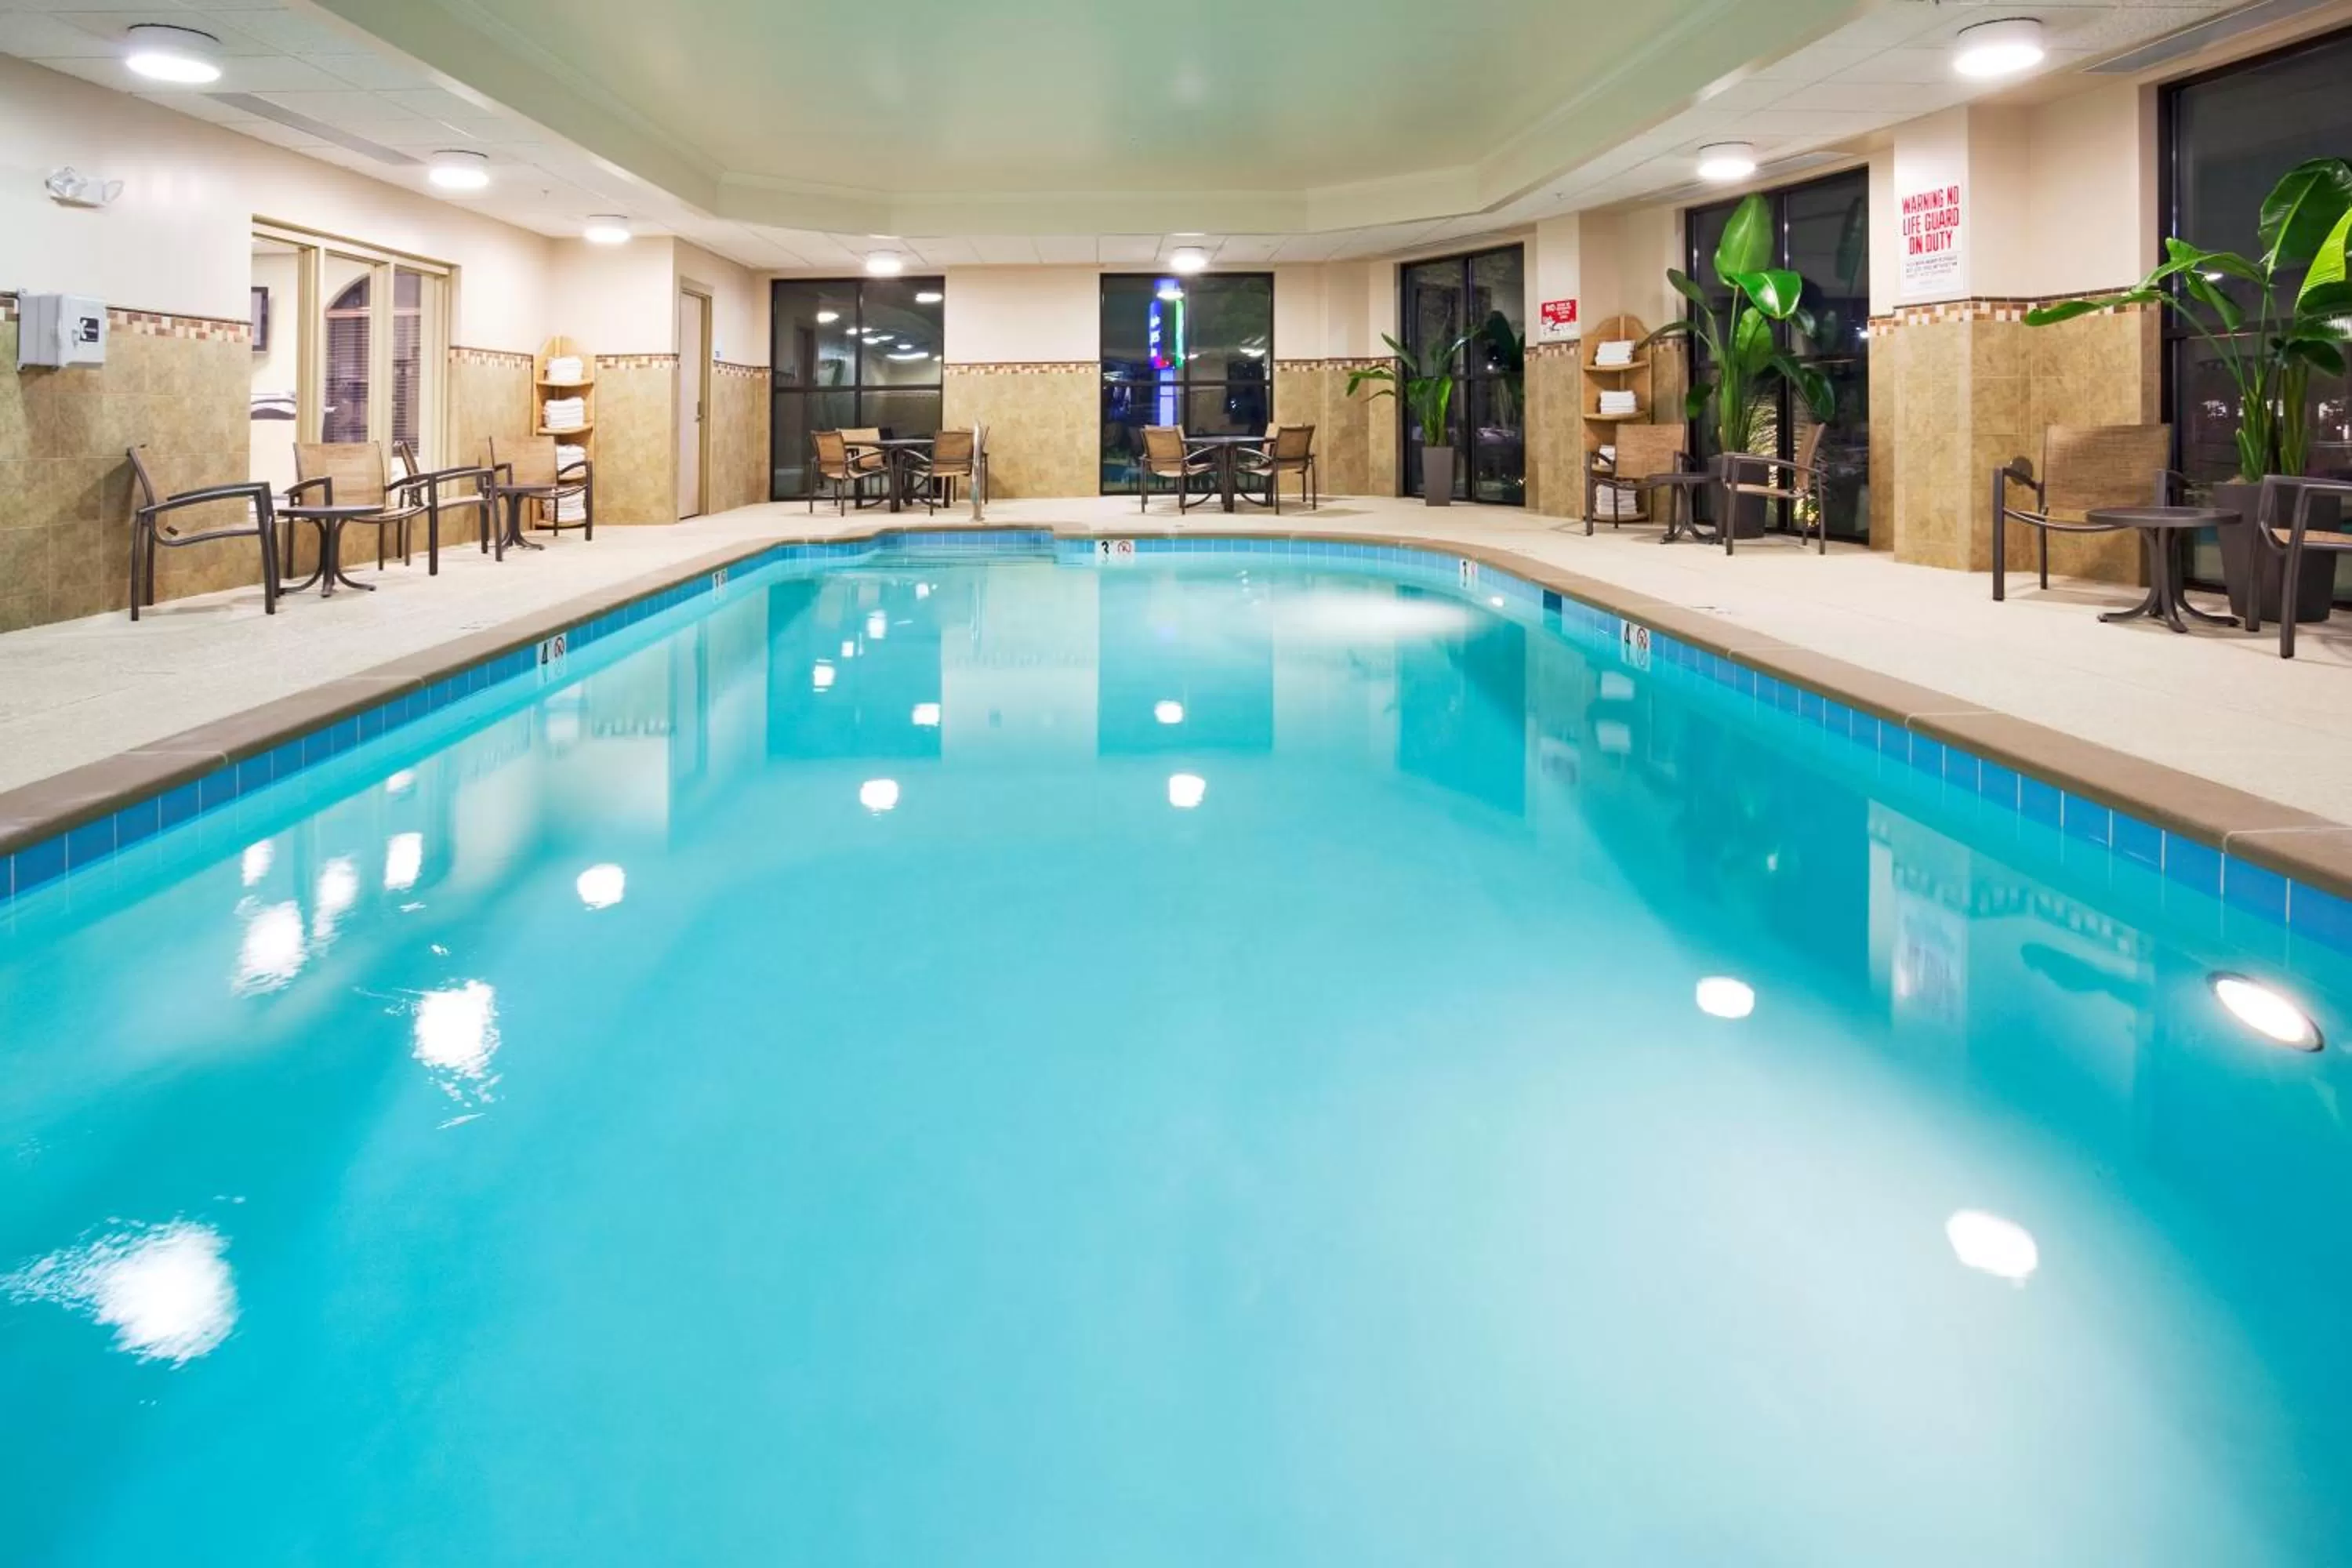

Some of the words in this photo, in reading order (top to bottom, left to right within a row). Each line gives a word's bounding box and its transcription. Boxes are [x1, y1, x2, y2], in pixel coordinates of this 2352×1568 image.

[1903, 189, 1944, 214] WARNING
[1947, 185, 1959, 205] NO
[1903, 215, 1921, 236] LIFE
[1925, 208, 1959, 230] GUARD
[1909, 235, 1922, 255] ON
[1926, 230, 1953, 252] DUTY
